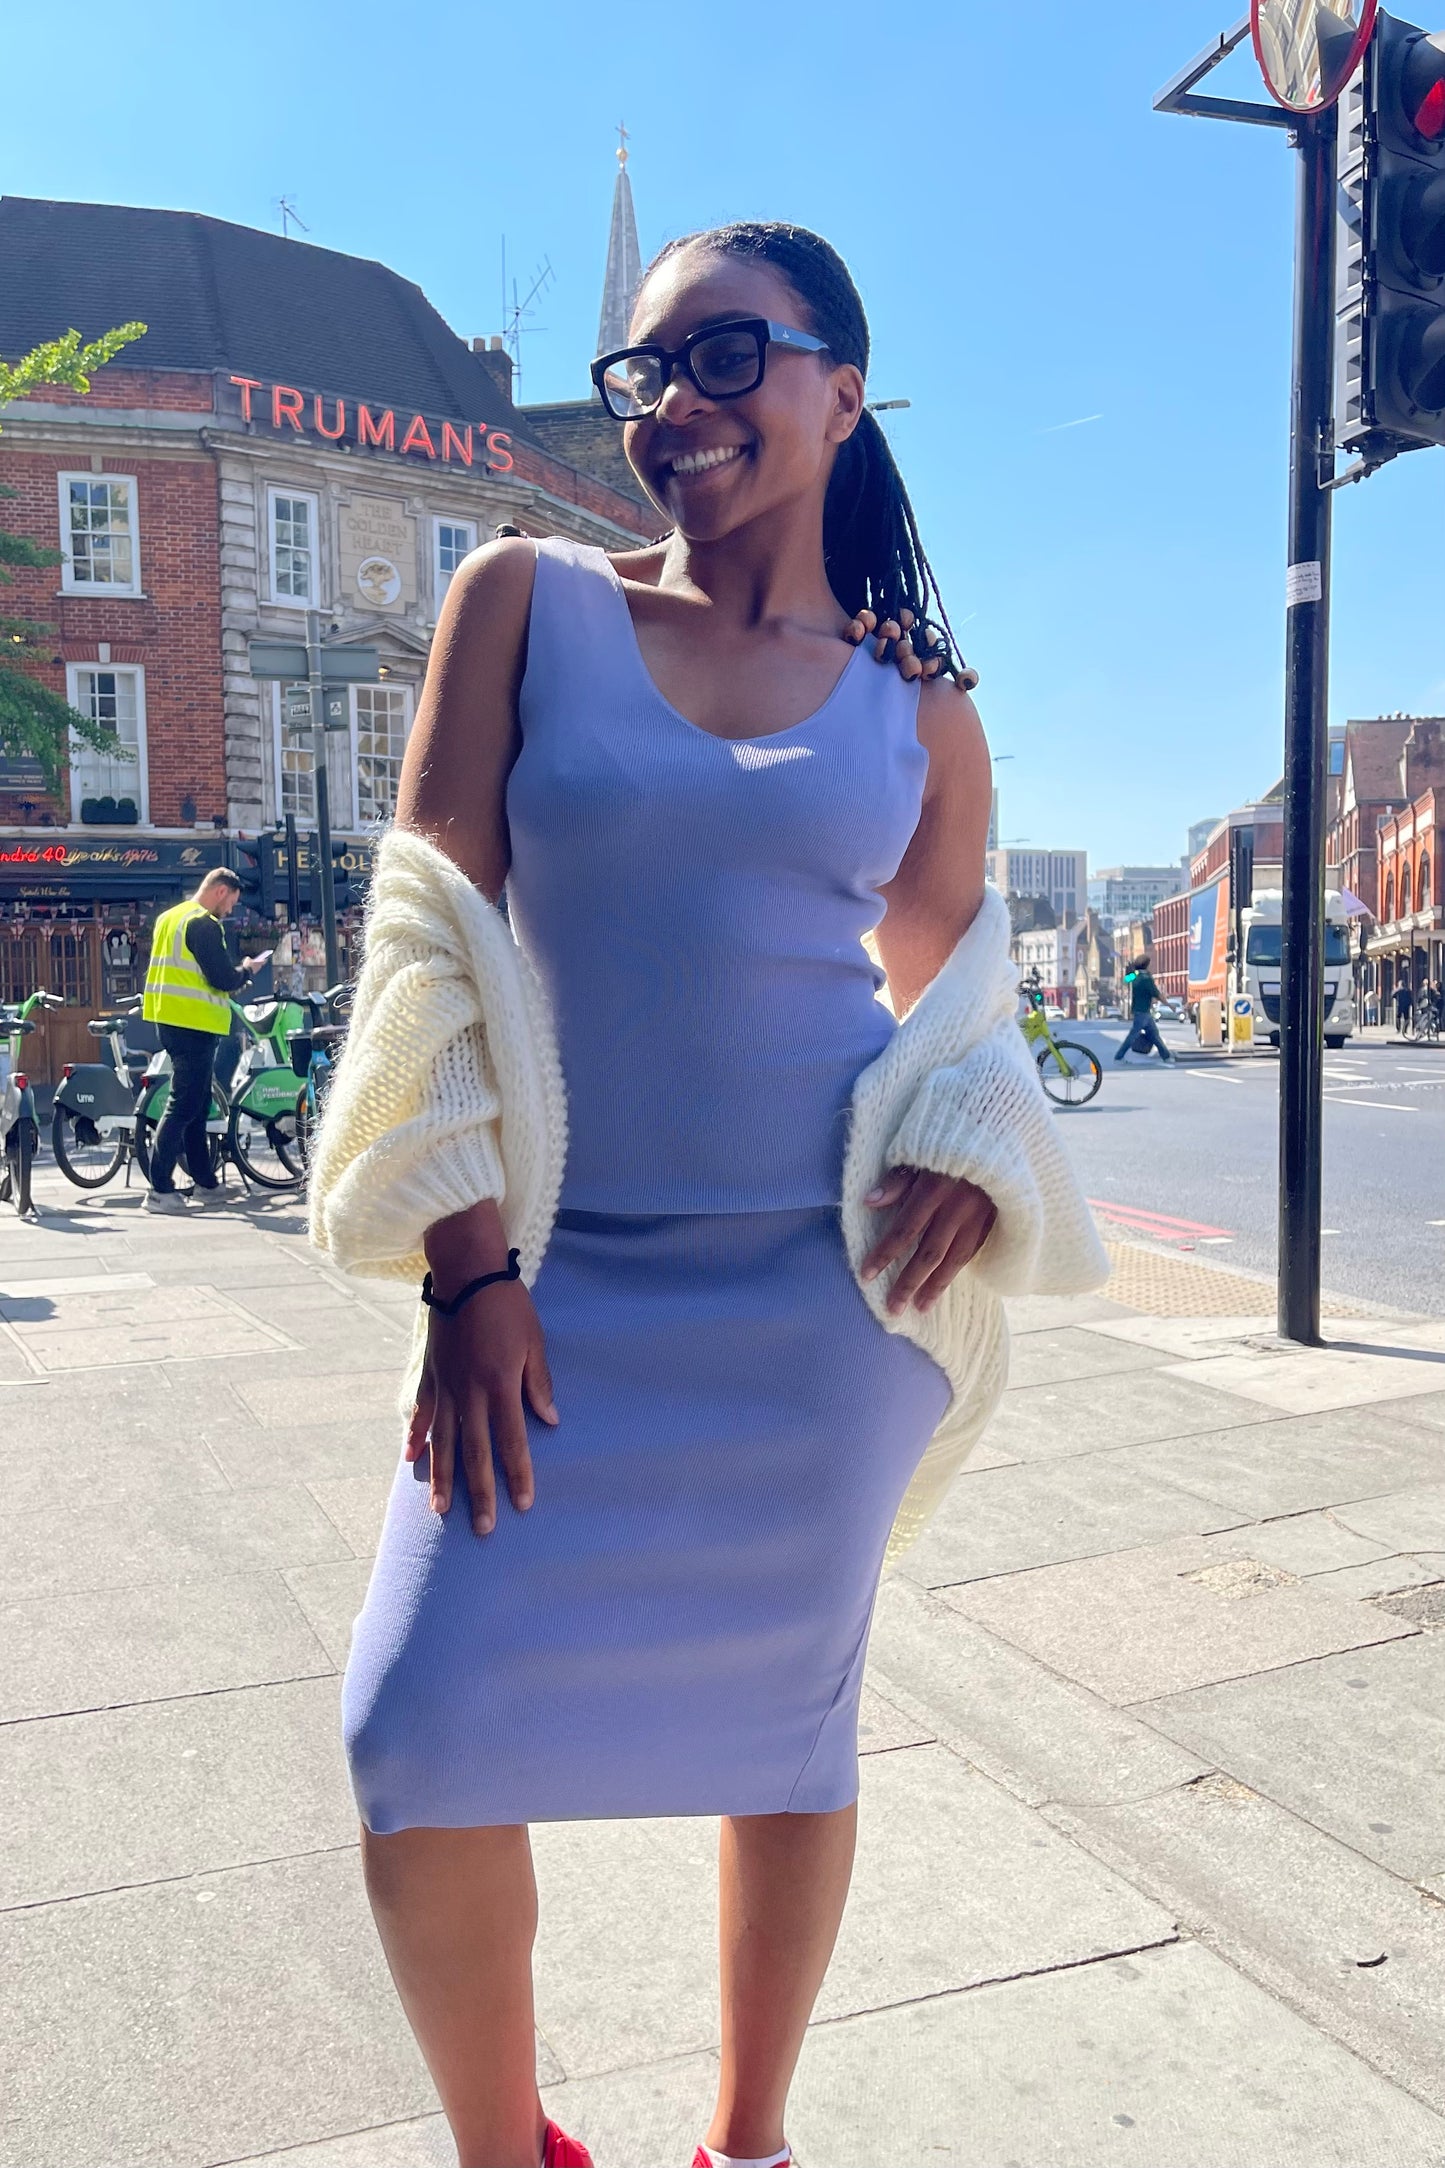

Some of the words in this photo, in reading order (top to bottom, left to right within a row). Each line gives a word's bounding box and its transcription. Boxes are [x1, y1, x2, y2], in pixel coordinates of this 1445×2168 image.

[229, 375, 515, 473] TRUMAN'S
[358, 502, 393, 519] THE
[347, 516, 407, 539] GOLDEN
[351, 533, 404, 556] HEART
[41, 844, 67, 863] 40
